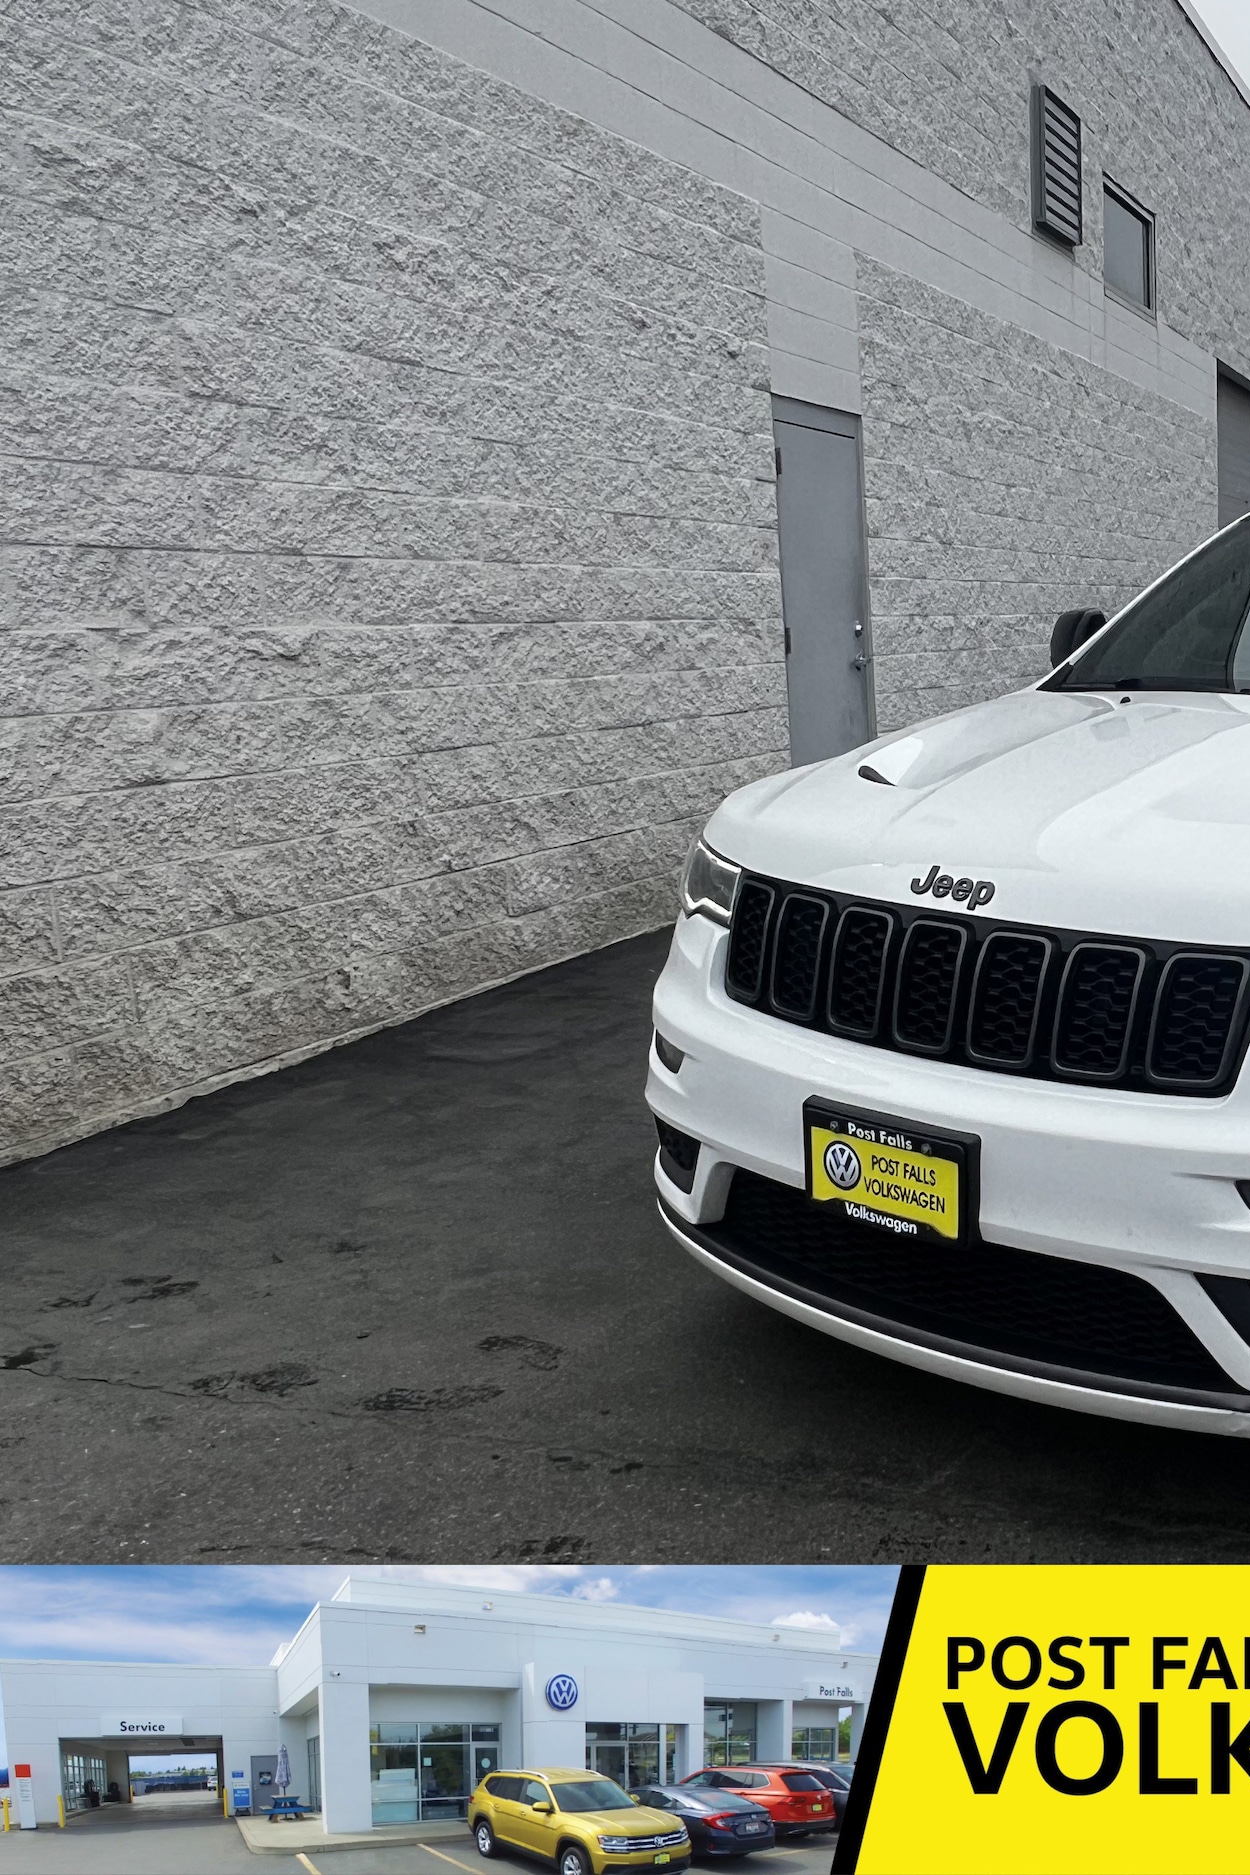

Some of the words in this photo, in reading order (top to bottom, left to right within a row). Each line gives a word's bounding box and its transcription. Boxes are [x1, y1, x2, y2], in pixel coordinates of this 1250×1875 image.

[910, 865, 996, 911] Jeep
[847, 1122, 876, 1142] Post
[879, 1131, 913, 1150] Falls
[871, 1154, 900, 1177] POST
[903, 1163, 936, 1186] FALLS
[863, 1176, 945, 1214] VOLKSWAGEN
[844, 1202, 918, 1234] Volkswagen
[819, 1685, 835, 1696] Post
[836, 1686, 853, 1697] Falls
[120, 1721, 165, 1732] Service
